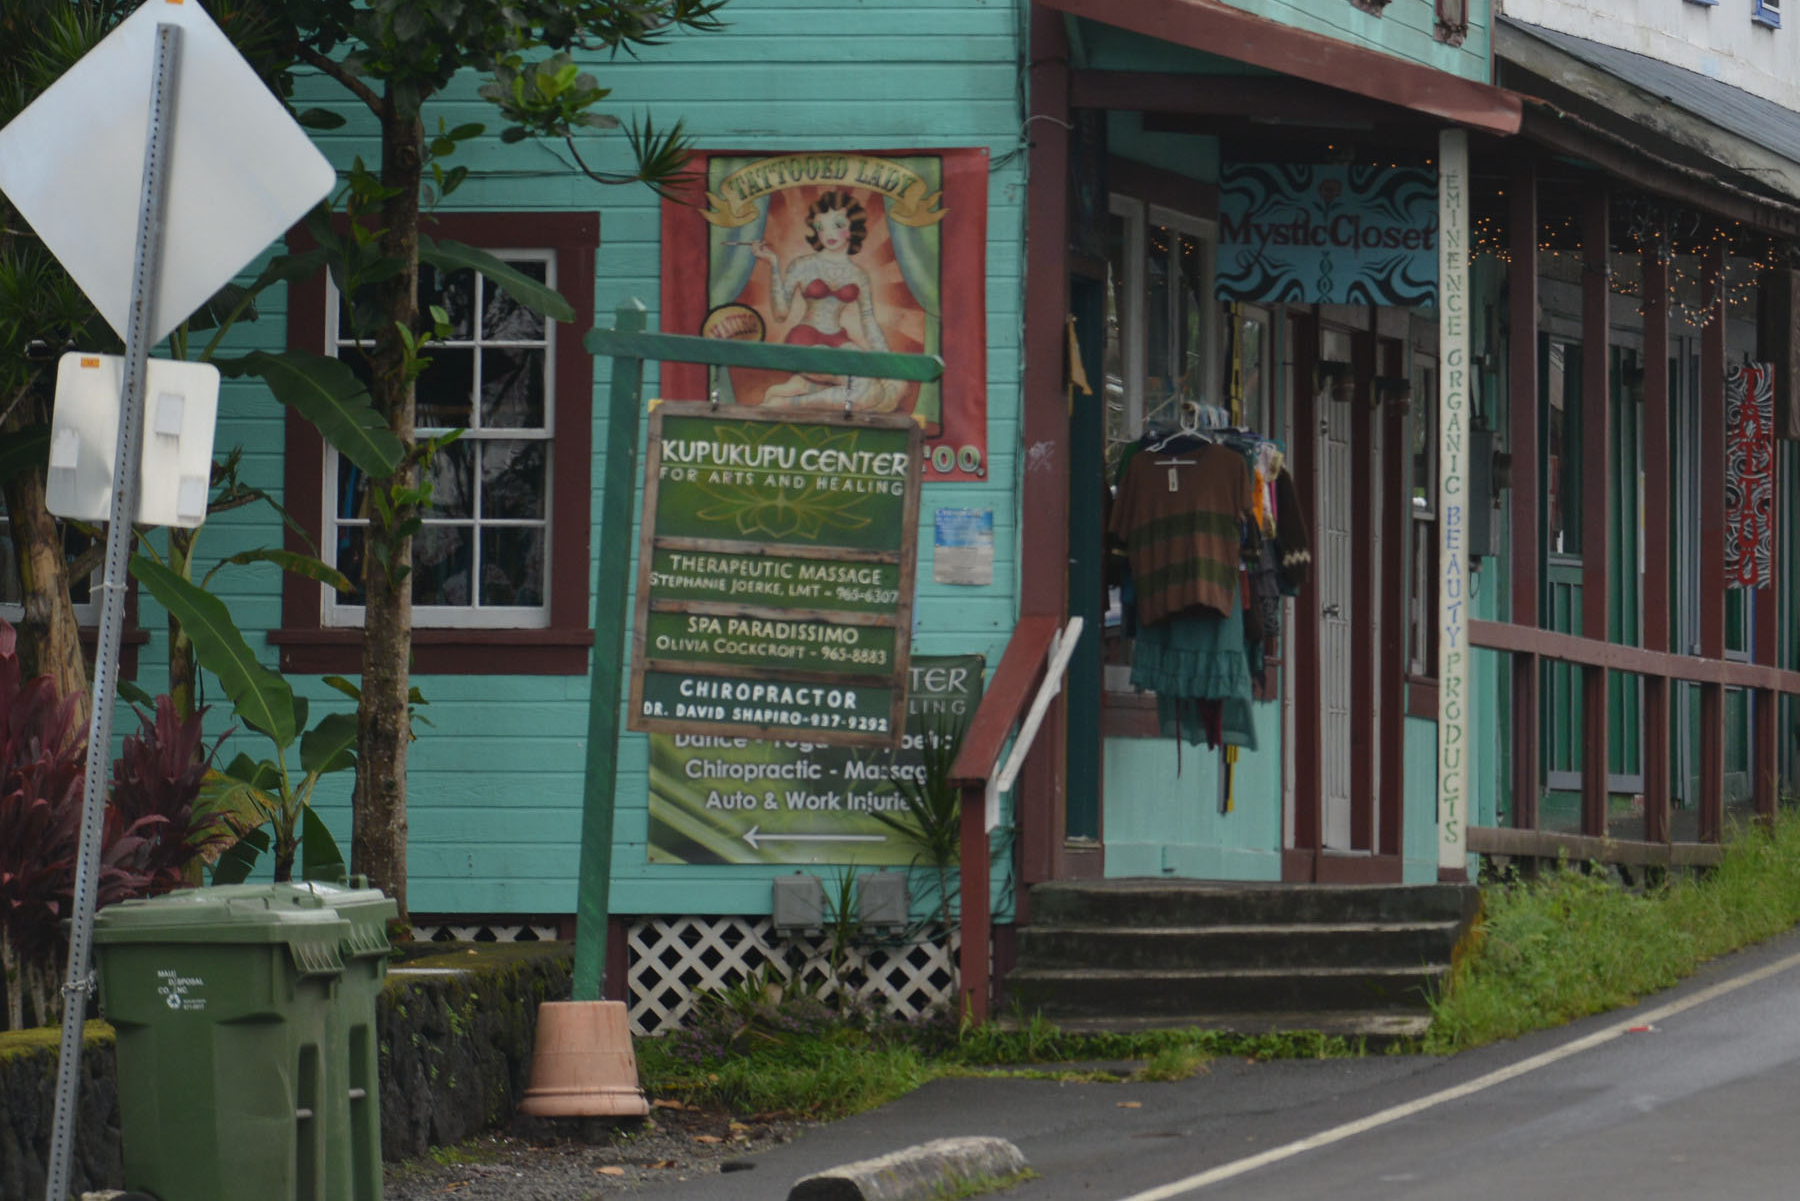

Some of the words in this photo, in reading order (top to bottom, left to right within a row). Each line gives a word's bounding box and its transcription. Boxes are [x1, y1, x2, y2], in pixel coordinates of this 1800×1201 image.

[728, 155, 848, 200] TATTOOED
[856, 158, 918, 197] LADY
[1445, 171, 1462, 337] EMINENCE
[1444, 348, 1462, 495] ORGANIC
[661, 439, 797, 469] KUPUKUPU
[800, 448, 909, 477] CENTER
[659, 466, 698, 483] FOR
[708, 470, 755, 486] ARTS
[764, 474, 806, 490] AND
[815, 477, 905, 496] HEALING
[1738, 367, 1763, 586] TATTOO
[650, 572, 726, 592] STEPHANIE
[788, 583, 822, 598] LMT
[670, 554, 793, 580] THERAPEUTIC
[799, 564, 883, 585] MASSAGE
[1446, 505, 1463, 648] BEAUTY
[688, 615, 722, 635] SPA
[728, 618, 860, 645] PARADISSIMO
[656, 635, 709, 653] OLIVIA
[713, 638, 805, 660] COCKCROFT
[821, 645, 888, 665] 965-8883
[643, 700, 669, 716] DR.
[676, 703, 725, 720] DAVID
[680, 679, 857, 710] CHIROPRACTOR
[1443, 652, 1462, 844] PRODUCTS
[685, 759, 822, 782] Chiropractic
[844, 760, 938, 786] Massag
[705, 790, 757, 811] Auto
[763, 792, 779, 811] &
[785, 790, 841, 811] Work
